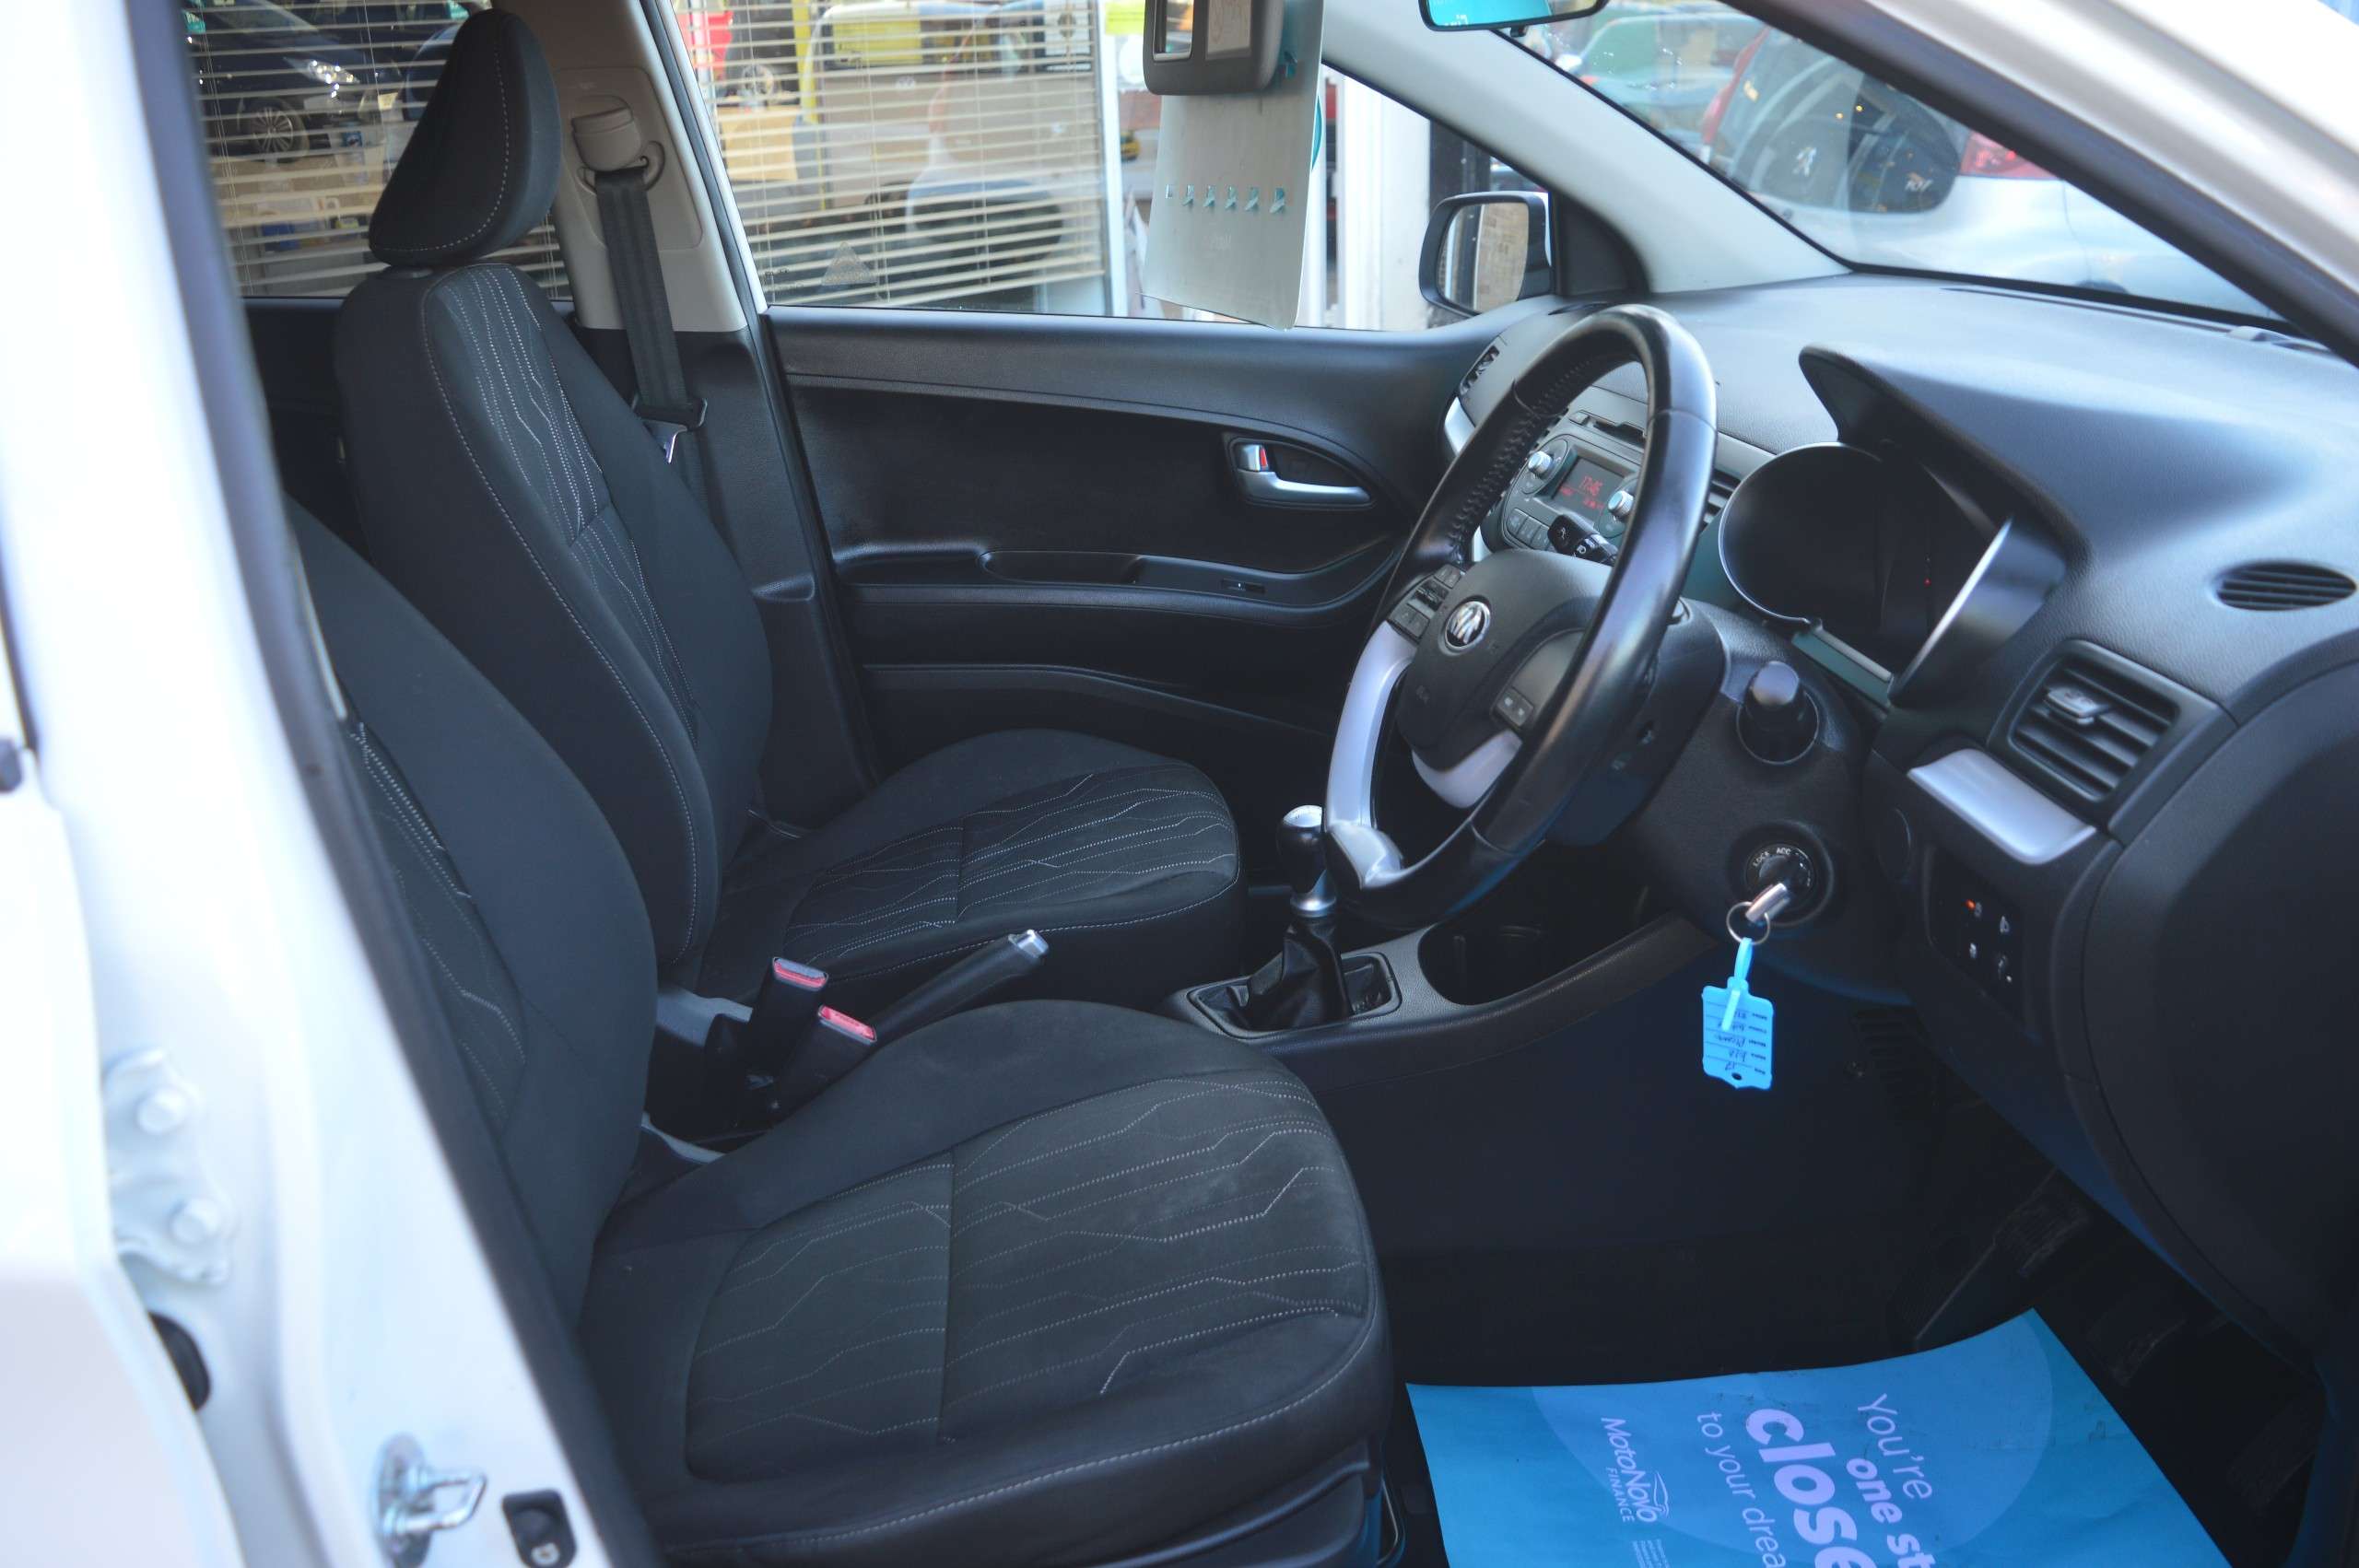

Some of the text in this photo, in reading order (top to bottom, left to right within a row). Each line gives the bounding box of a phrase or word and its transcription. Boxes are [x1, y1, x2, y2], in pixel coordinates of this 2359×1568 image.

[1776, 847, 1791, 856] ACC
[1601, 1417, 1659, 1523] MotoNovo
[1857, 1393, 1933, 1499] You're
[1606, 1466, 1636, 1522] FINANCE
[1696, 1411, 1787, 1568] to your drea
[1846, 1457, 1903, 1524] one
